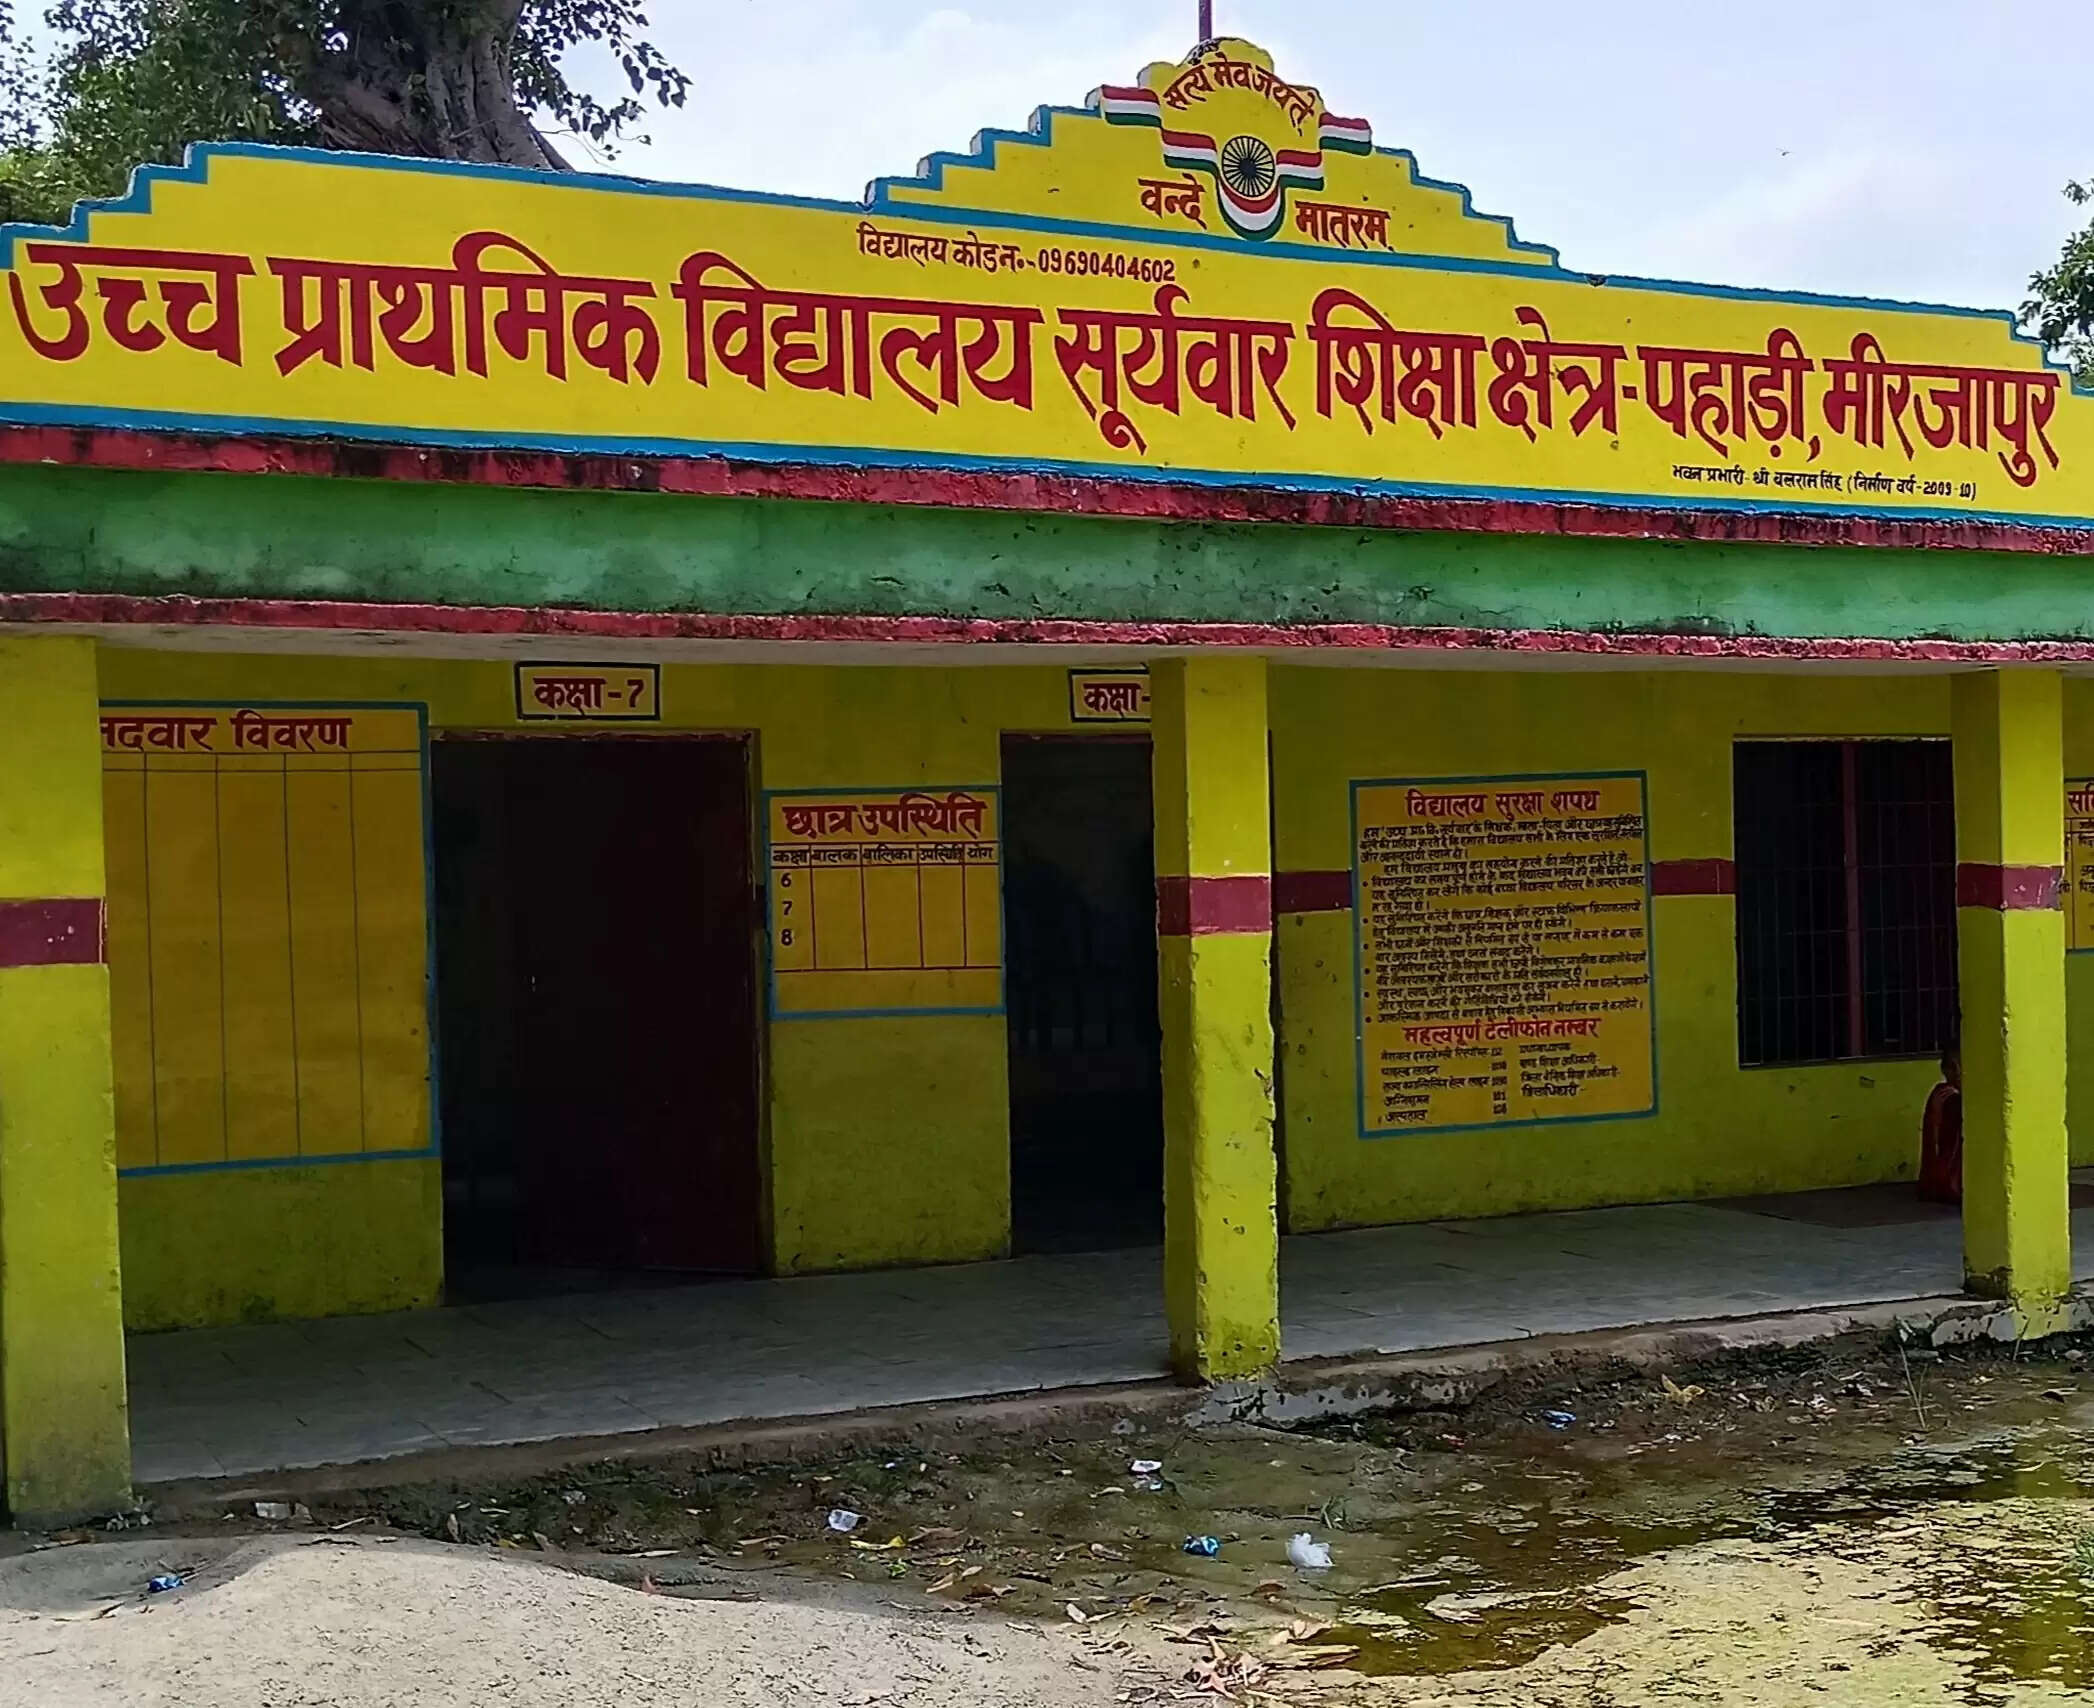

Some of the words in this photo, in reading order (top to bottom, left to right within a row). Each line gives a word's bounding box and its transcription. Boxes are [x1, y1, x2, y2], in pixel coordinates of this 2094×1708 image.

[1137, 172, 1207, 230] वन्दे
[856, 221, 949, 267] विद्यालय
[6, 241, 253, 368] उच्च
[264, 231, 661, 388] प्राथमिक
[671, 251, 1046, 415] विद्यालय
[1052, 284, 1294, 456] सूर्यवार
[1307, 287, 1488, 441] शिक्षा
[1821, 331, 2062, 489] मीरजापुर
[1753, 467, 1770, 486] श्री
[229, 709, 353, 752] विवरण
[782, 804, 859, 839] छात्र
[858, 792, 988, 839] उपस्थिति
[1404, 788, 1488, 817] विद्यालय
[1495, 791, 1544, 821] सुरक्षा
[1550, 790, 1600, 814] शपथ
[781, 873, 792, 888] 6
[782, 901, 793, 915] 7
[781, 929, 793, 946] 8
[1402, 1019, 1481, 1046] महत्वपूर्ण
[1553, 1018, 1602, 1038] नम्बर
